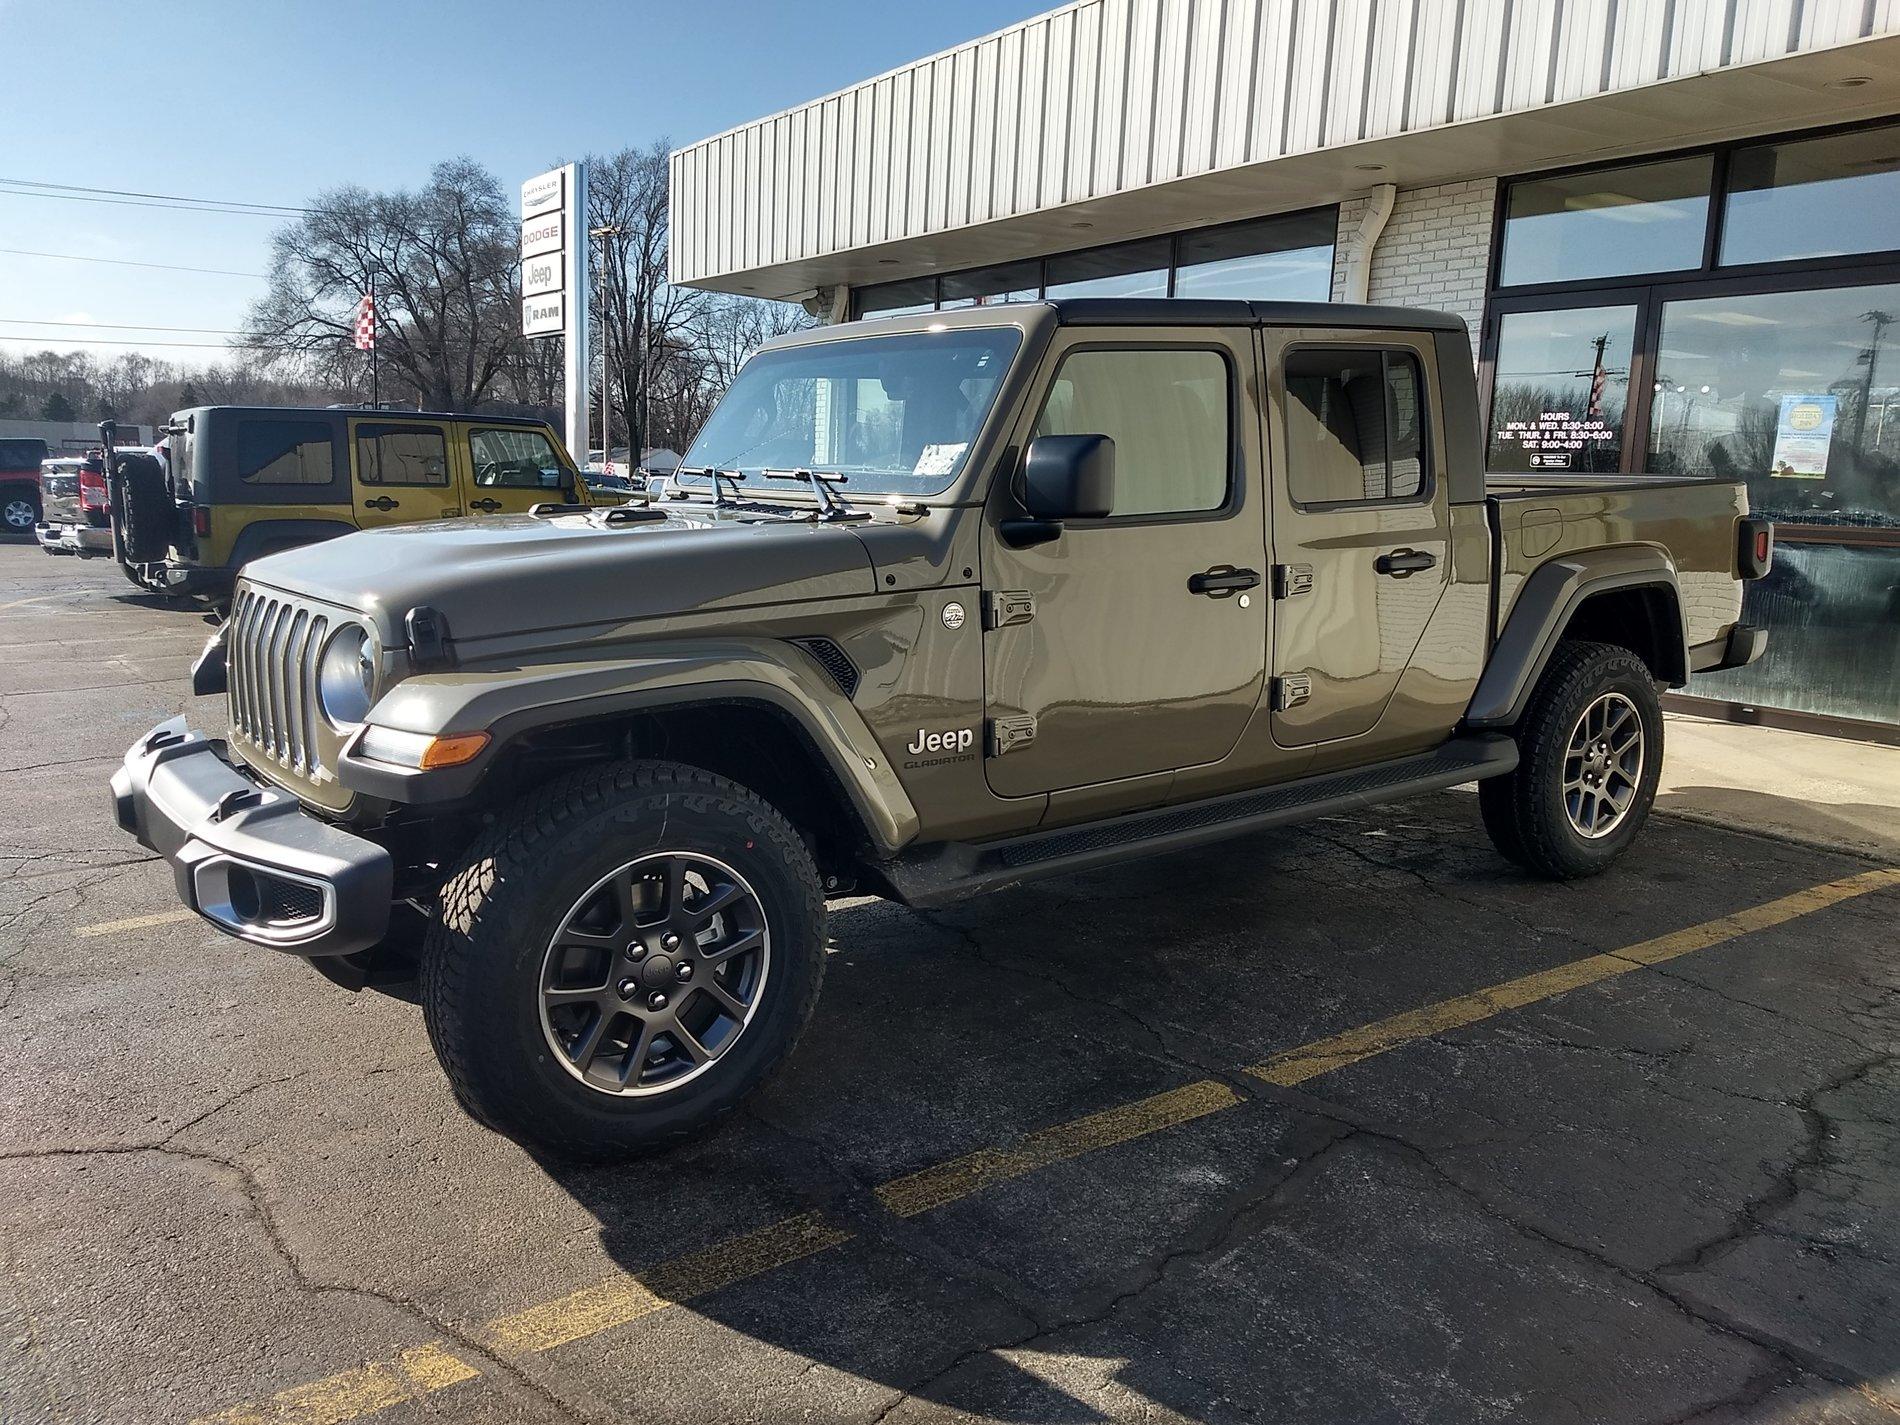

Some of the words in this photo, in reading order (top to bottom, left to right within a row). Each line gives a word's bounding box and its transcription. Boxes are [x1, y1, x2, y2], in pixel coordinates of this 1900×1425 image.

[523, 180, 557, 198] CHRYSLER
[523, 225, 558, 246] DODGE
[528, 263, 552, 287] Jeep
[532, 306, 559, 321] RAM
[1540, 412, 1570, 421] HOURS
[1506, 421, 1528, 430] MON.
[1529, 421, 1537, 430] &
[1538, 421, 1560, 430] WED.
[1561, 421, 1604, 430] 8:30-8:00
[1497, 430, 1515, 440] TUE.
[1518, 430, 1542, 440] THUR.
[1543, 430, 1551, 440] &
[1570, 430, 1613, 440] 8:30-6:00
[1522, 440, 1540, 449] SAT.
[1541, 440, 1583, 449] 9:00-4:00
[907, 727, 974, 755] Jeep
[903, 754, 975, 769] GLADIATOR
